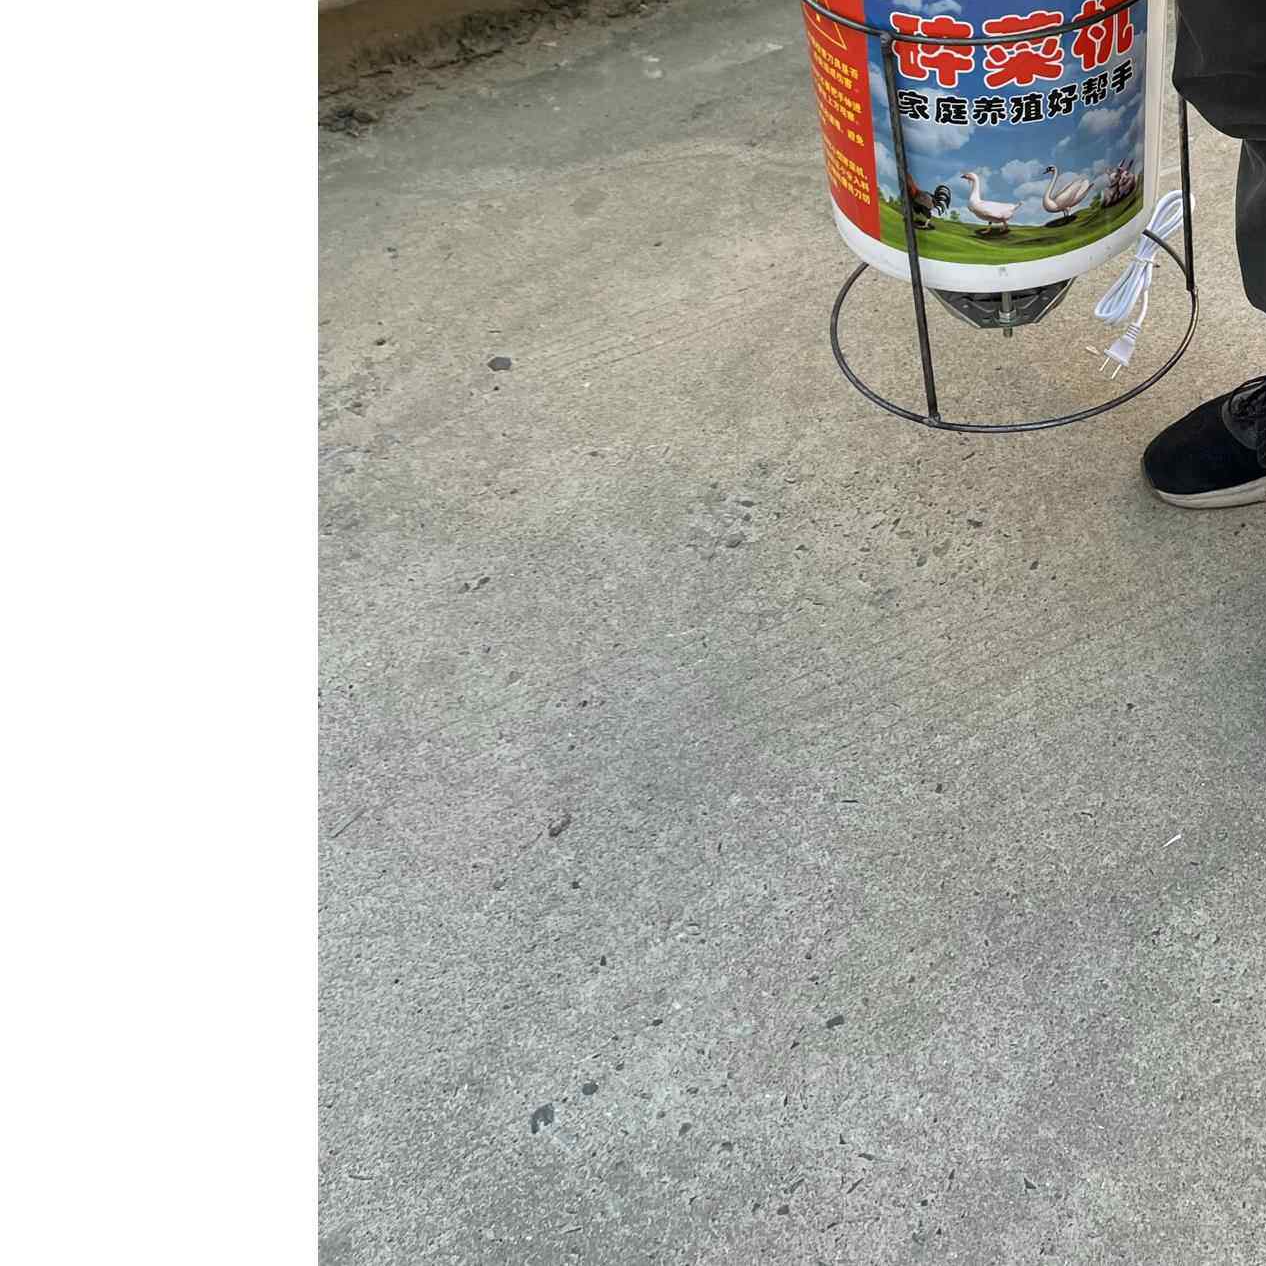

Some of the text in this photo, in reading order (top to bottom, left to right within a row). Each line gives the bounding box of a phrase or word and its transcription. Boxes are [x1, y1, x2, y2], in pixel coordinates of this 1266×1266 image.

[896, 58, 1135, 127] 家庭养殖好帮手
